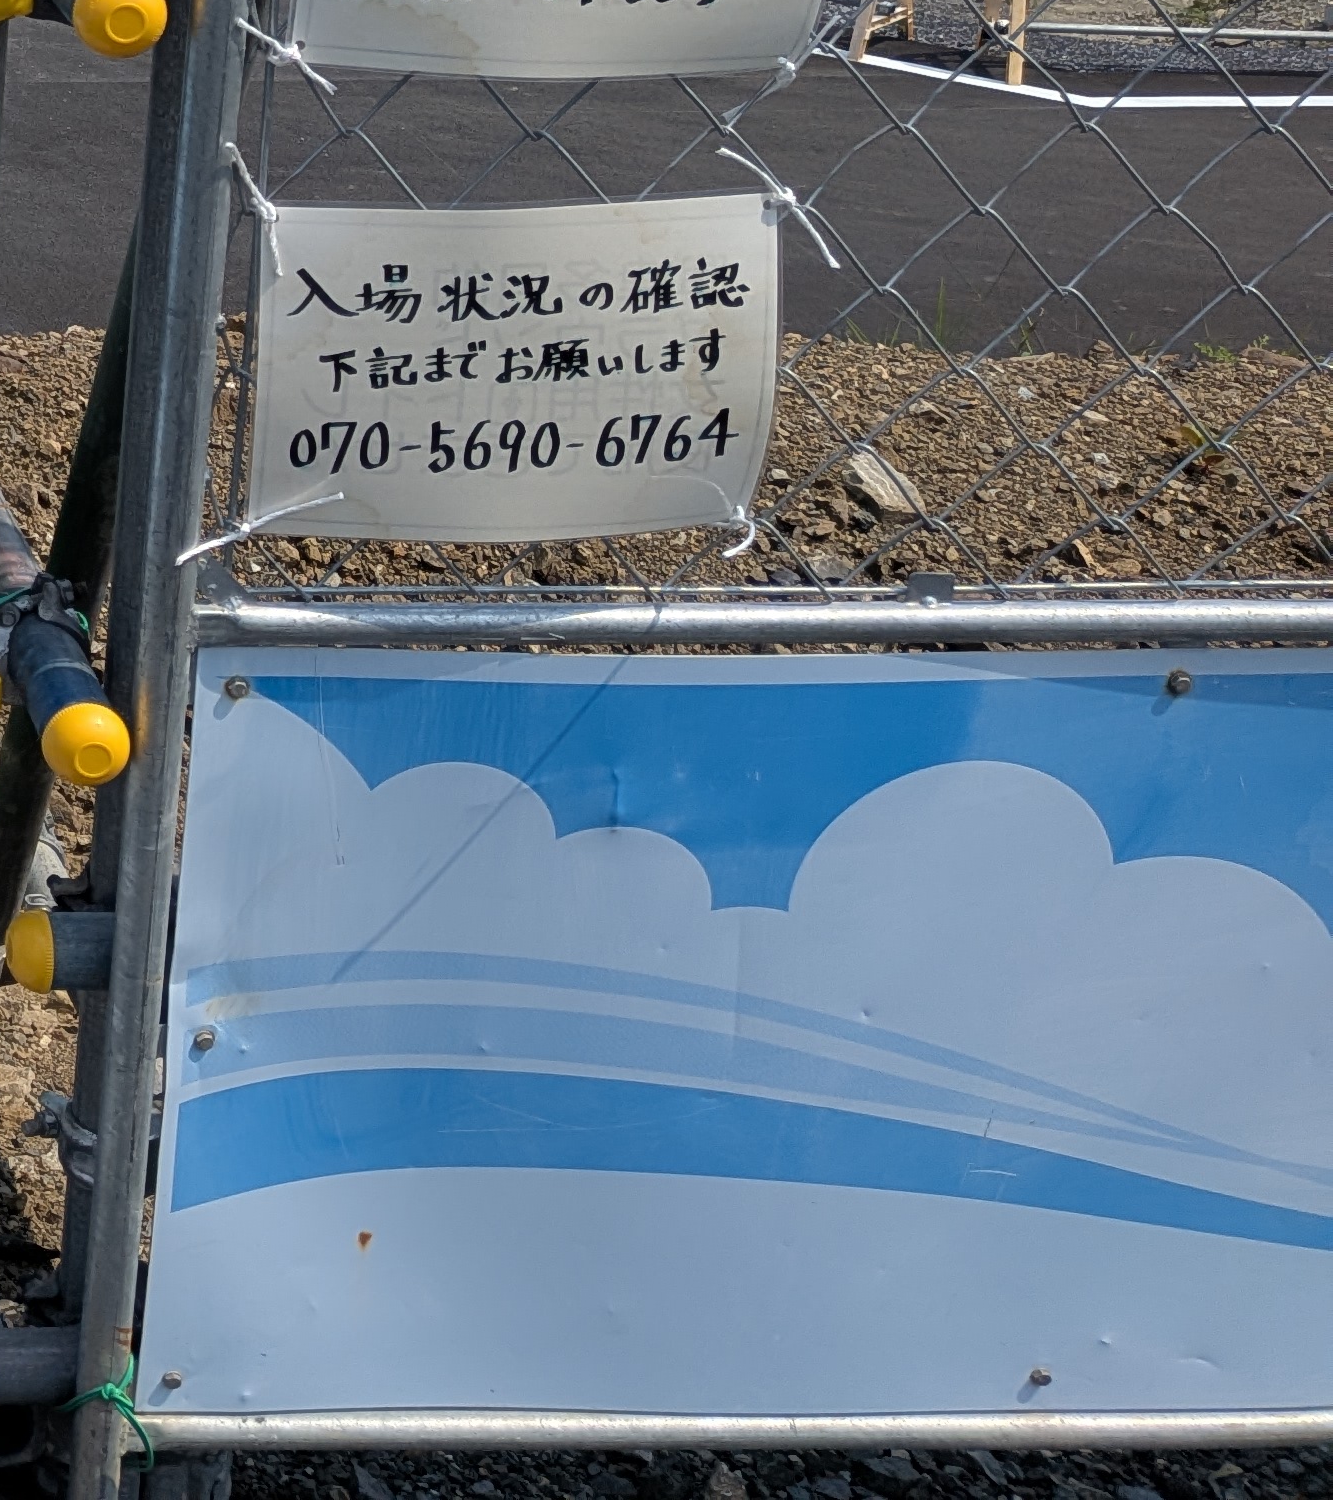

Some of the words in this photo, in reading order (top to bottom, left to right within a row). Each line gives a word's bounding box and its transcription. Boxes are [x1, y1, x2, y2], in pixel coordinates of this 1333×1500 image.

[288, 257, 751, 324] 入場状況の確認
[318, 327, 728, 393] 下記までお願いします
[289, 408, 740, 475] 070-5690-6764
